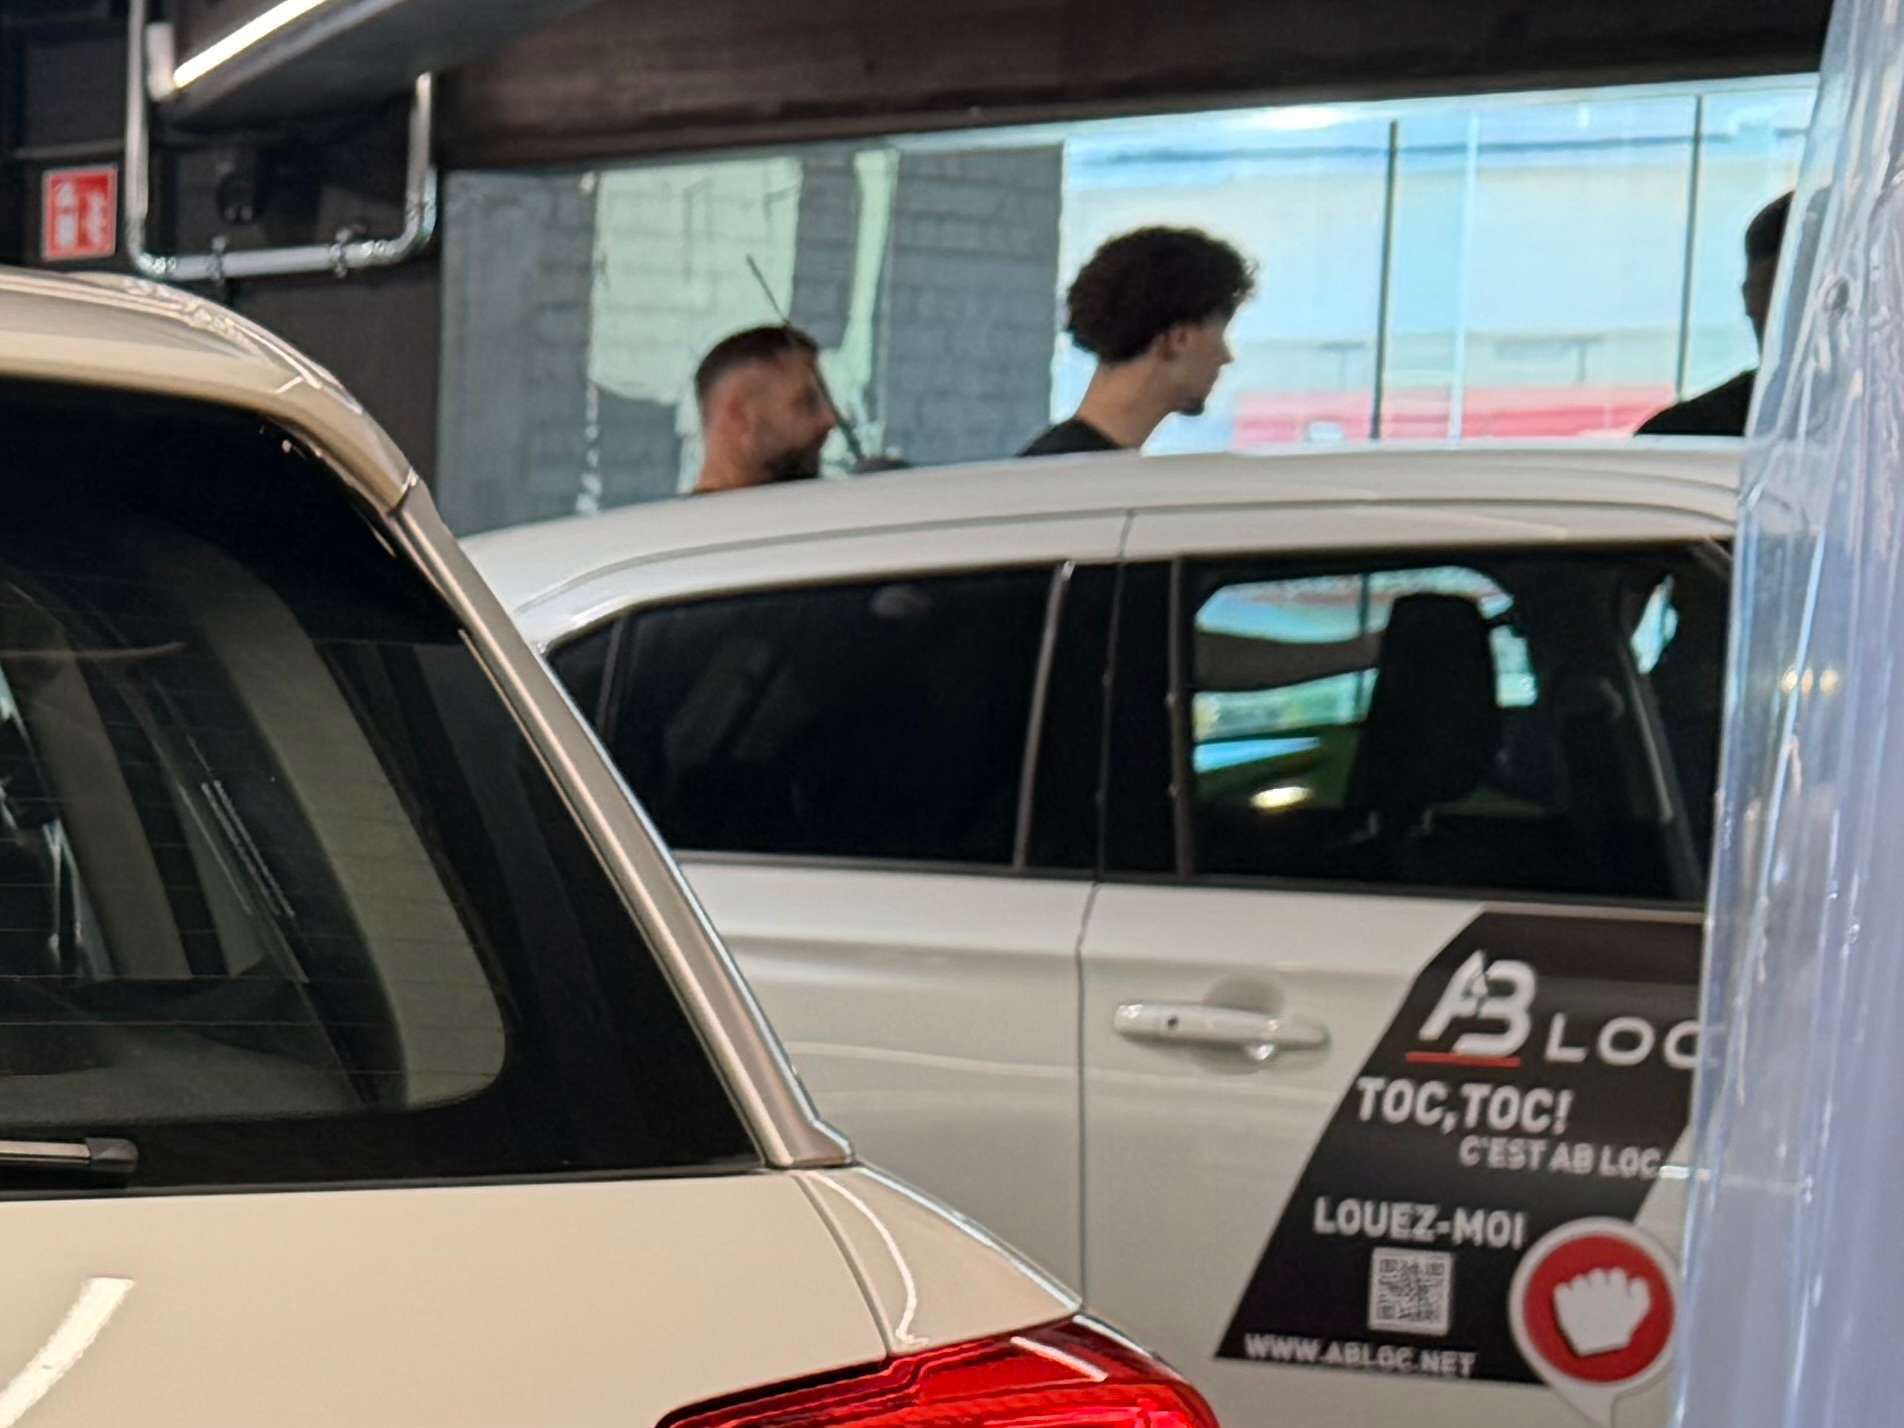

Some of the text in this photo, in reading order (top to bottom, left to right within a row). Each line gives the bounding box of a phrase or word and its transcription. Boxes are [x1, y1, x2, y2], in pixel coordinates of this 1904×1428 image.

[1459, 1135, 1661, 1181] C'EST AB LOC
[1313, 1197, 1527, 1248] LOUEZ-MOI
[1245, 1333, 1478, 1376] WWW.ABLOC.NET
